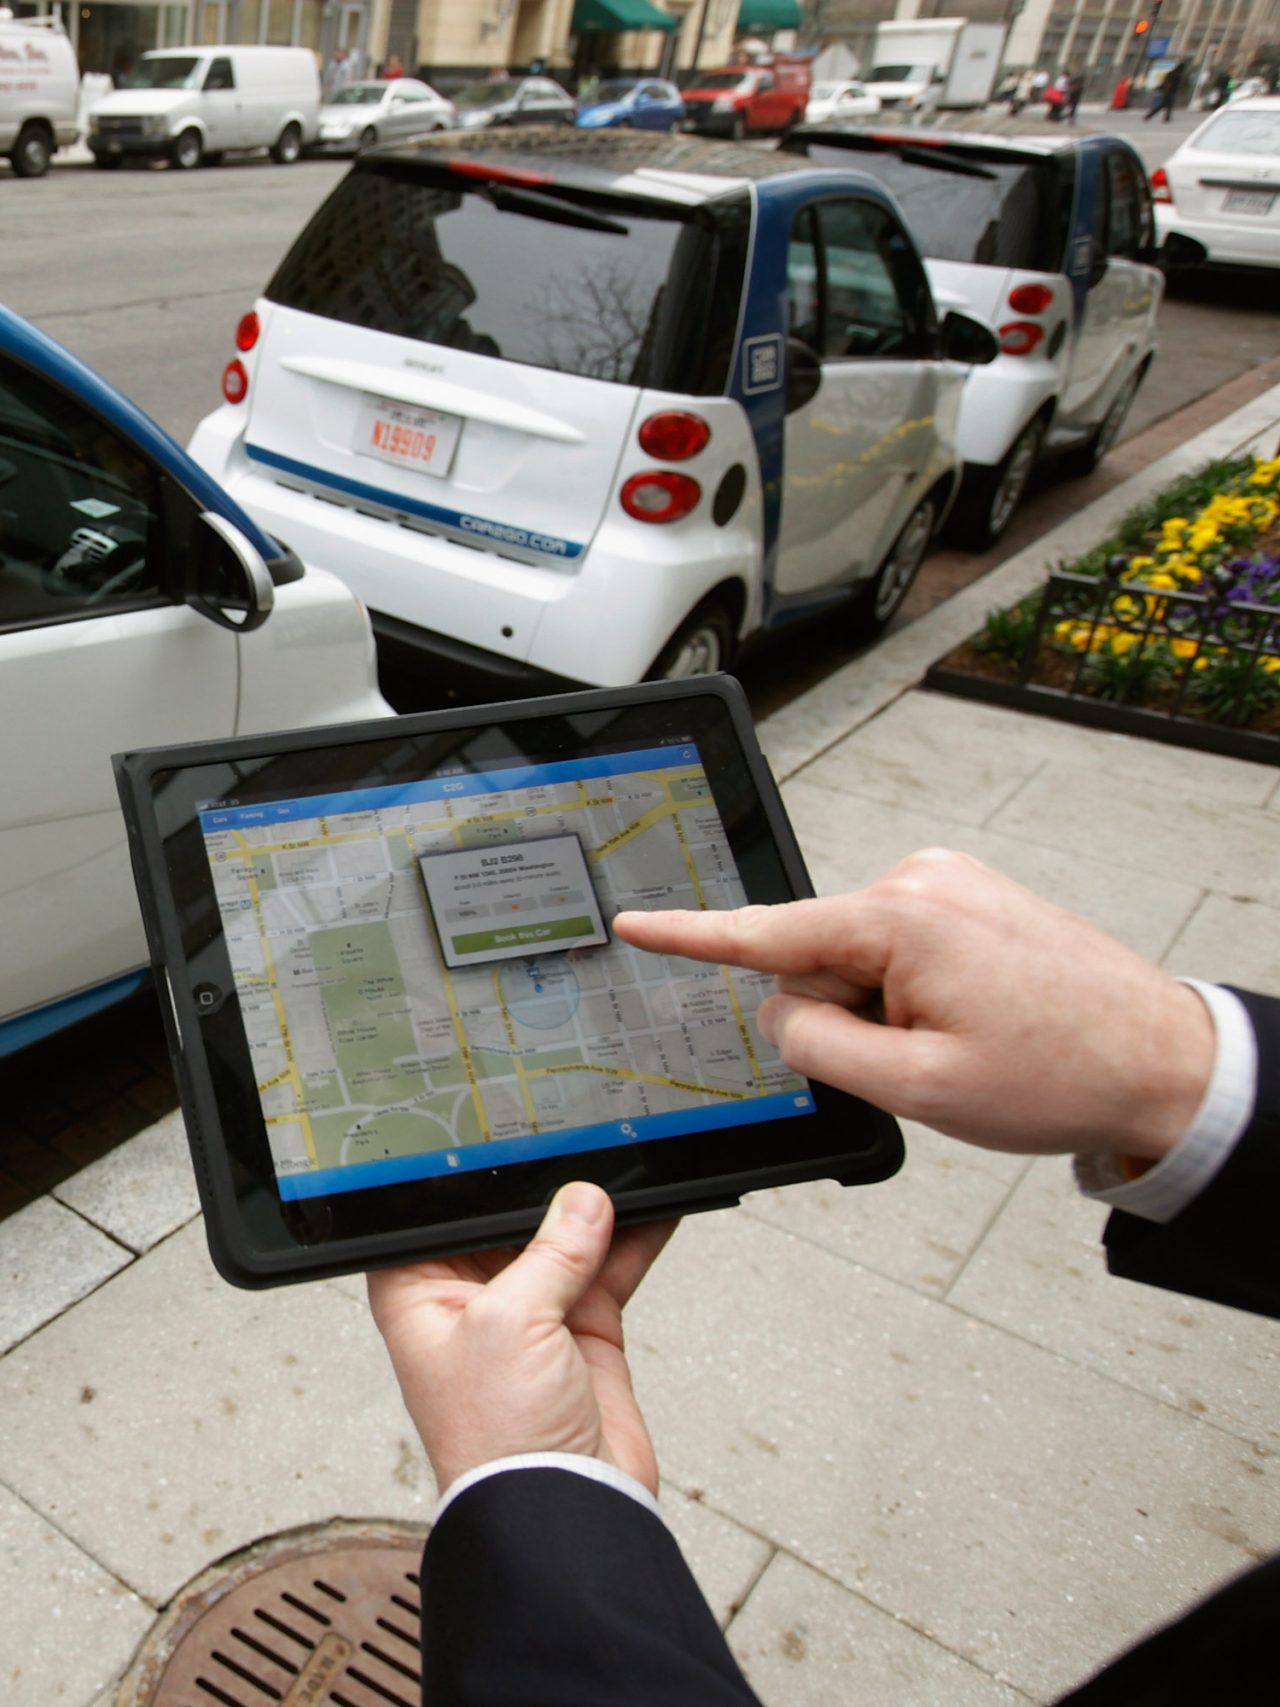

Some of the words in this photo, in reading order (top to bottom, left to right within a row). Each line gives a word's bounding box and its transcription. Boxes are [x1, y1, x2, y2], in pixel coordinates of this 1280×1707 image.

[518, 861, 555, 872] Washington
[493, 932, 517, 943] Book
[517, 929, 535, 939] this
[534, 927, 552, 936] Car
[547, 1065, 589, 1075] Pennsylvania
